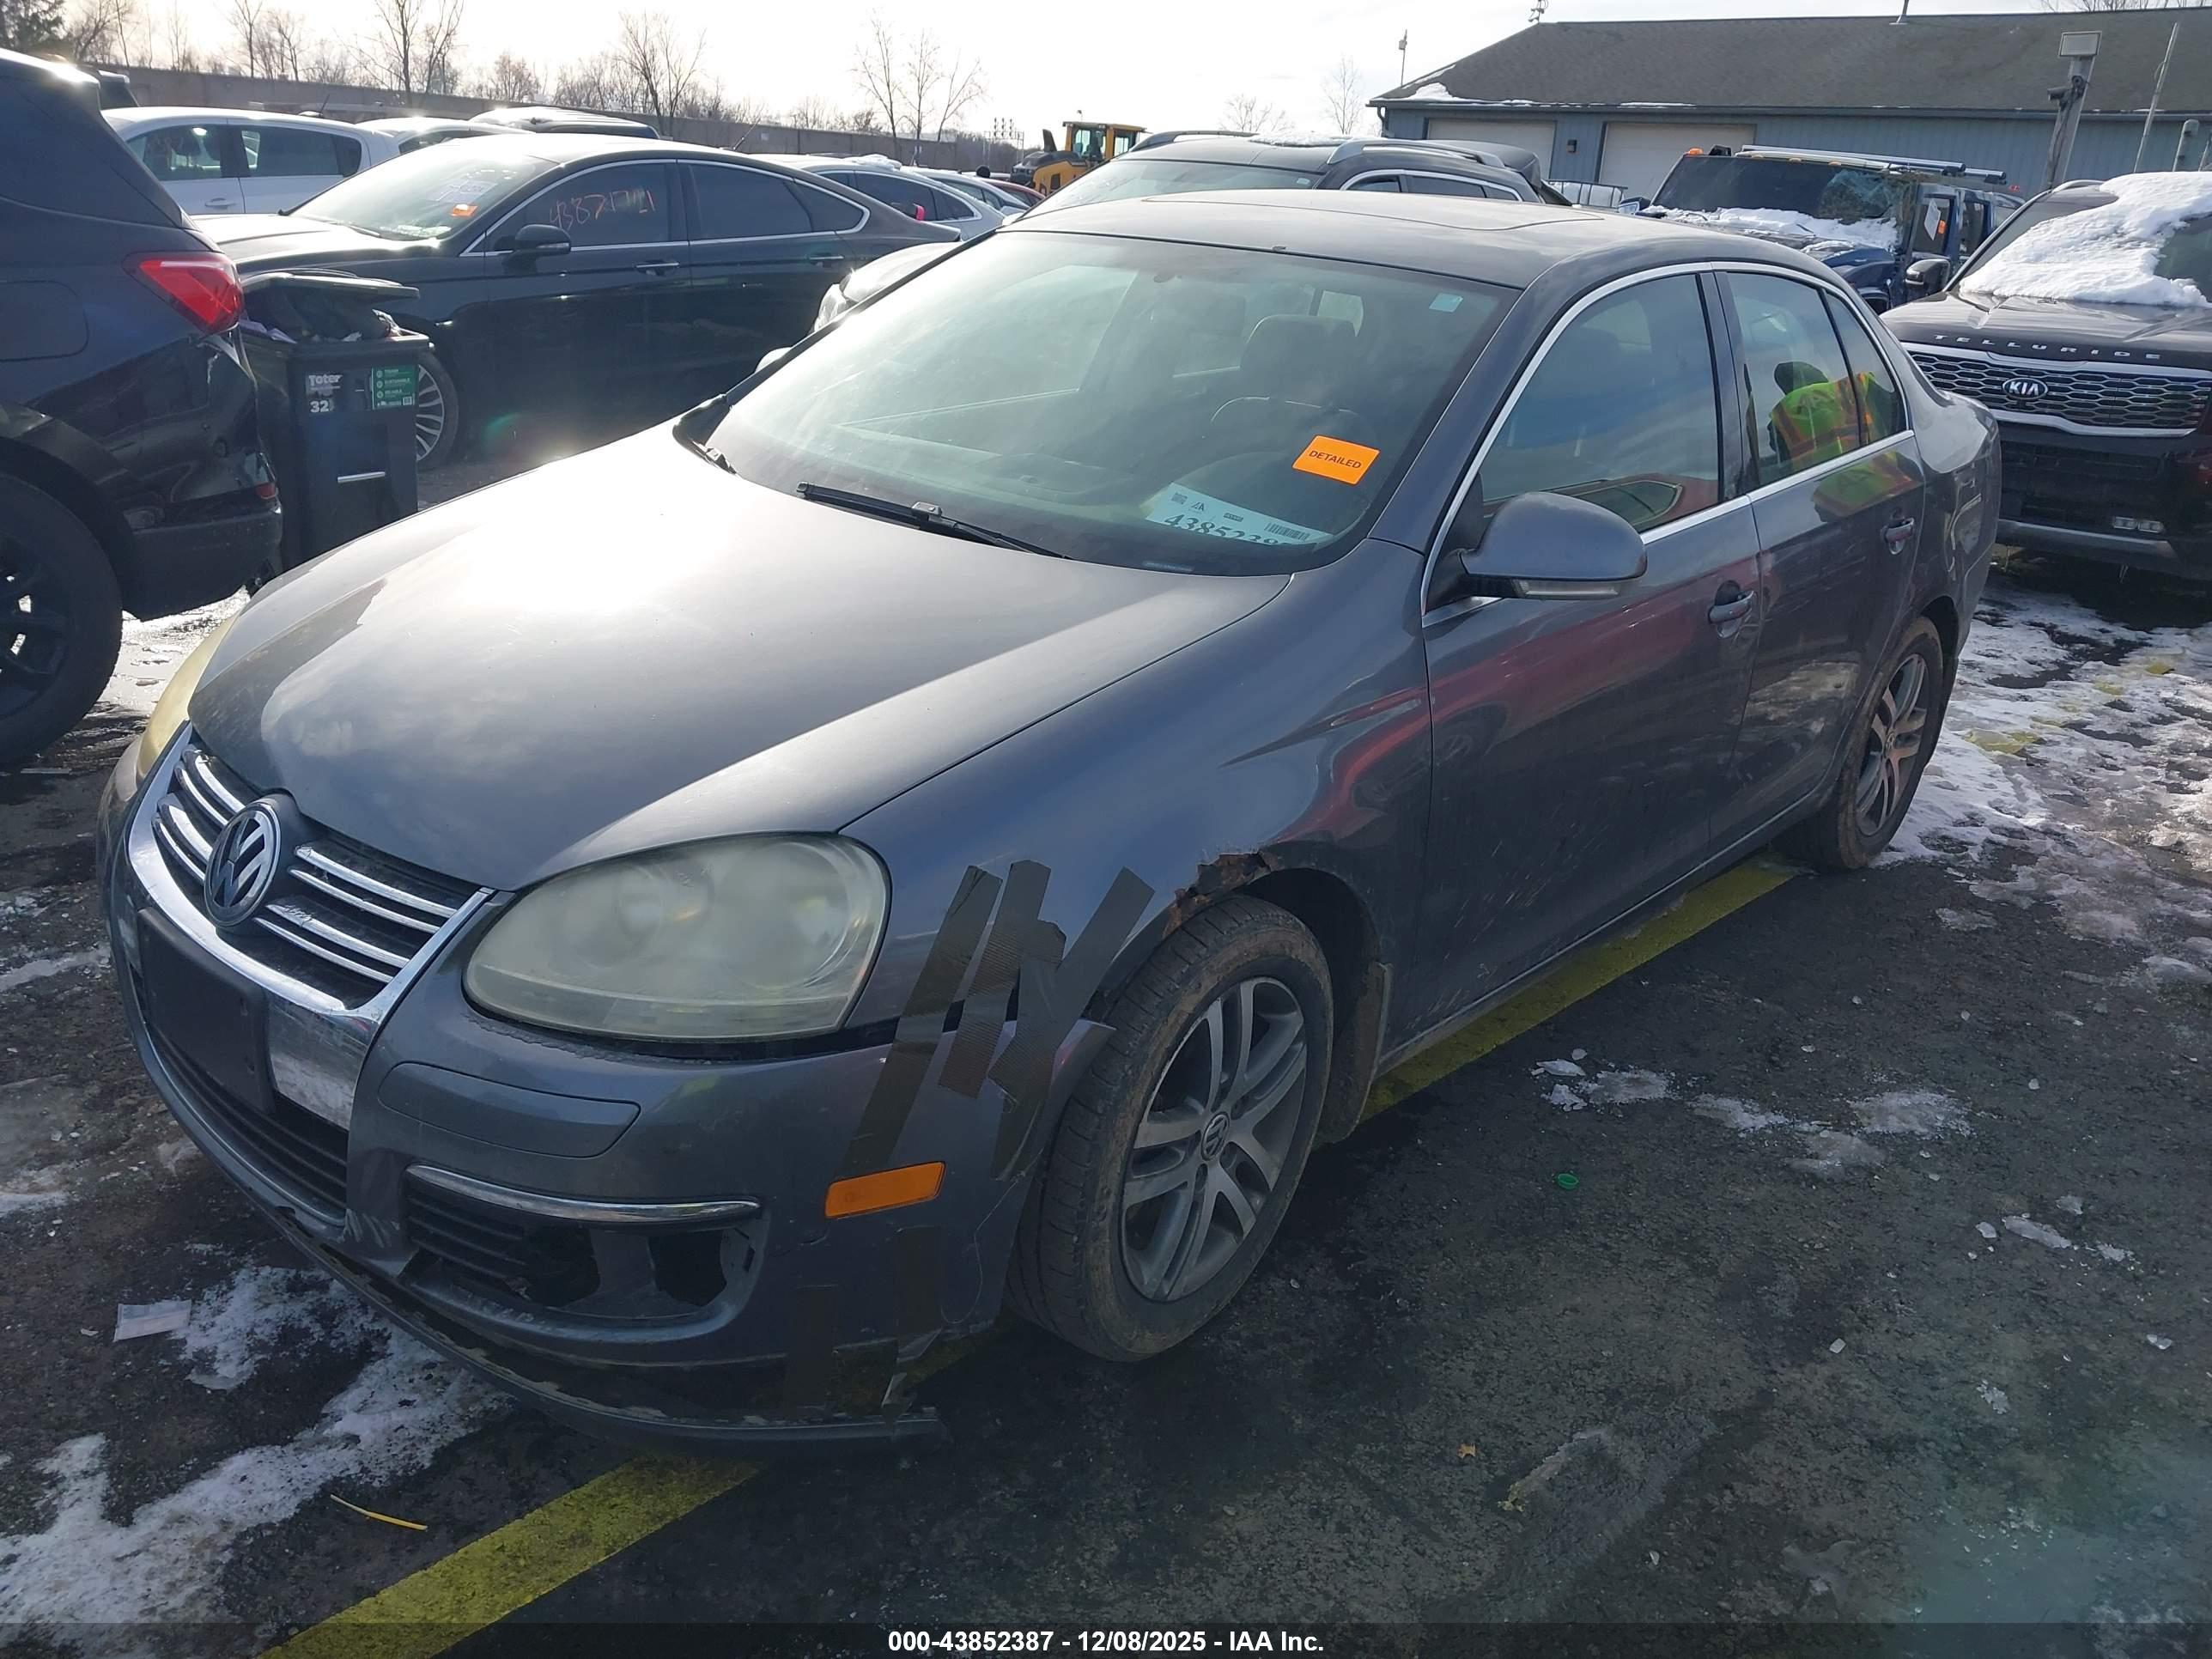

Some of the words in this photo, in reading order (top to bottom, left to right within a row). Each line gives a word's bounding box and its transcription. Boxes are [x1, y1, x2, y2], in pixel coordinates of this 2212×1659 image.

[1934, 333, 2161, 360] TELLURIDE
[308, 374, 343, 386] Toter
[2007, 380, 2041, 396] KIA
[1309, 450, 1362, 470] DETAILED
